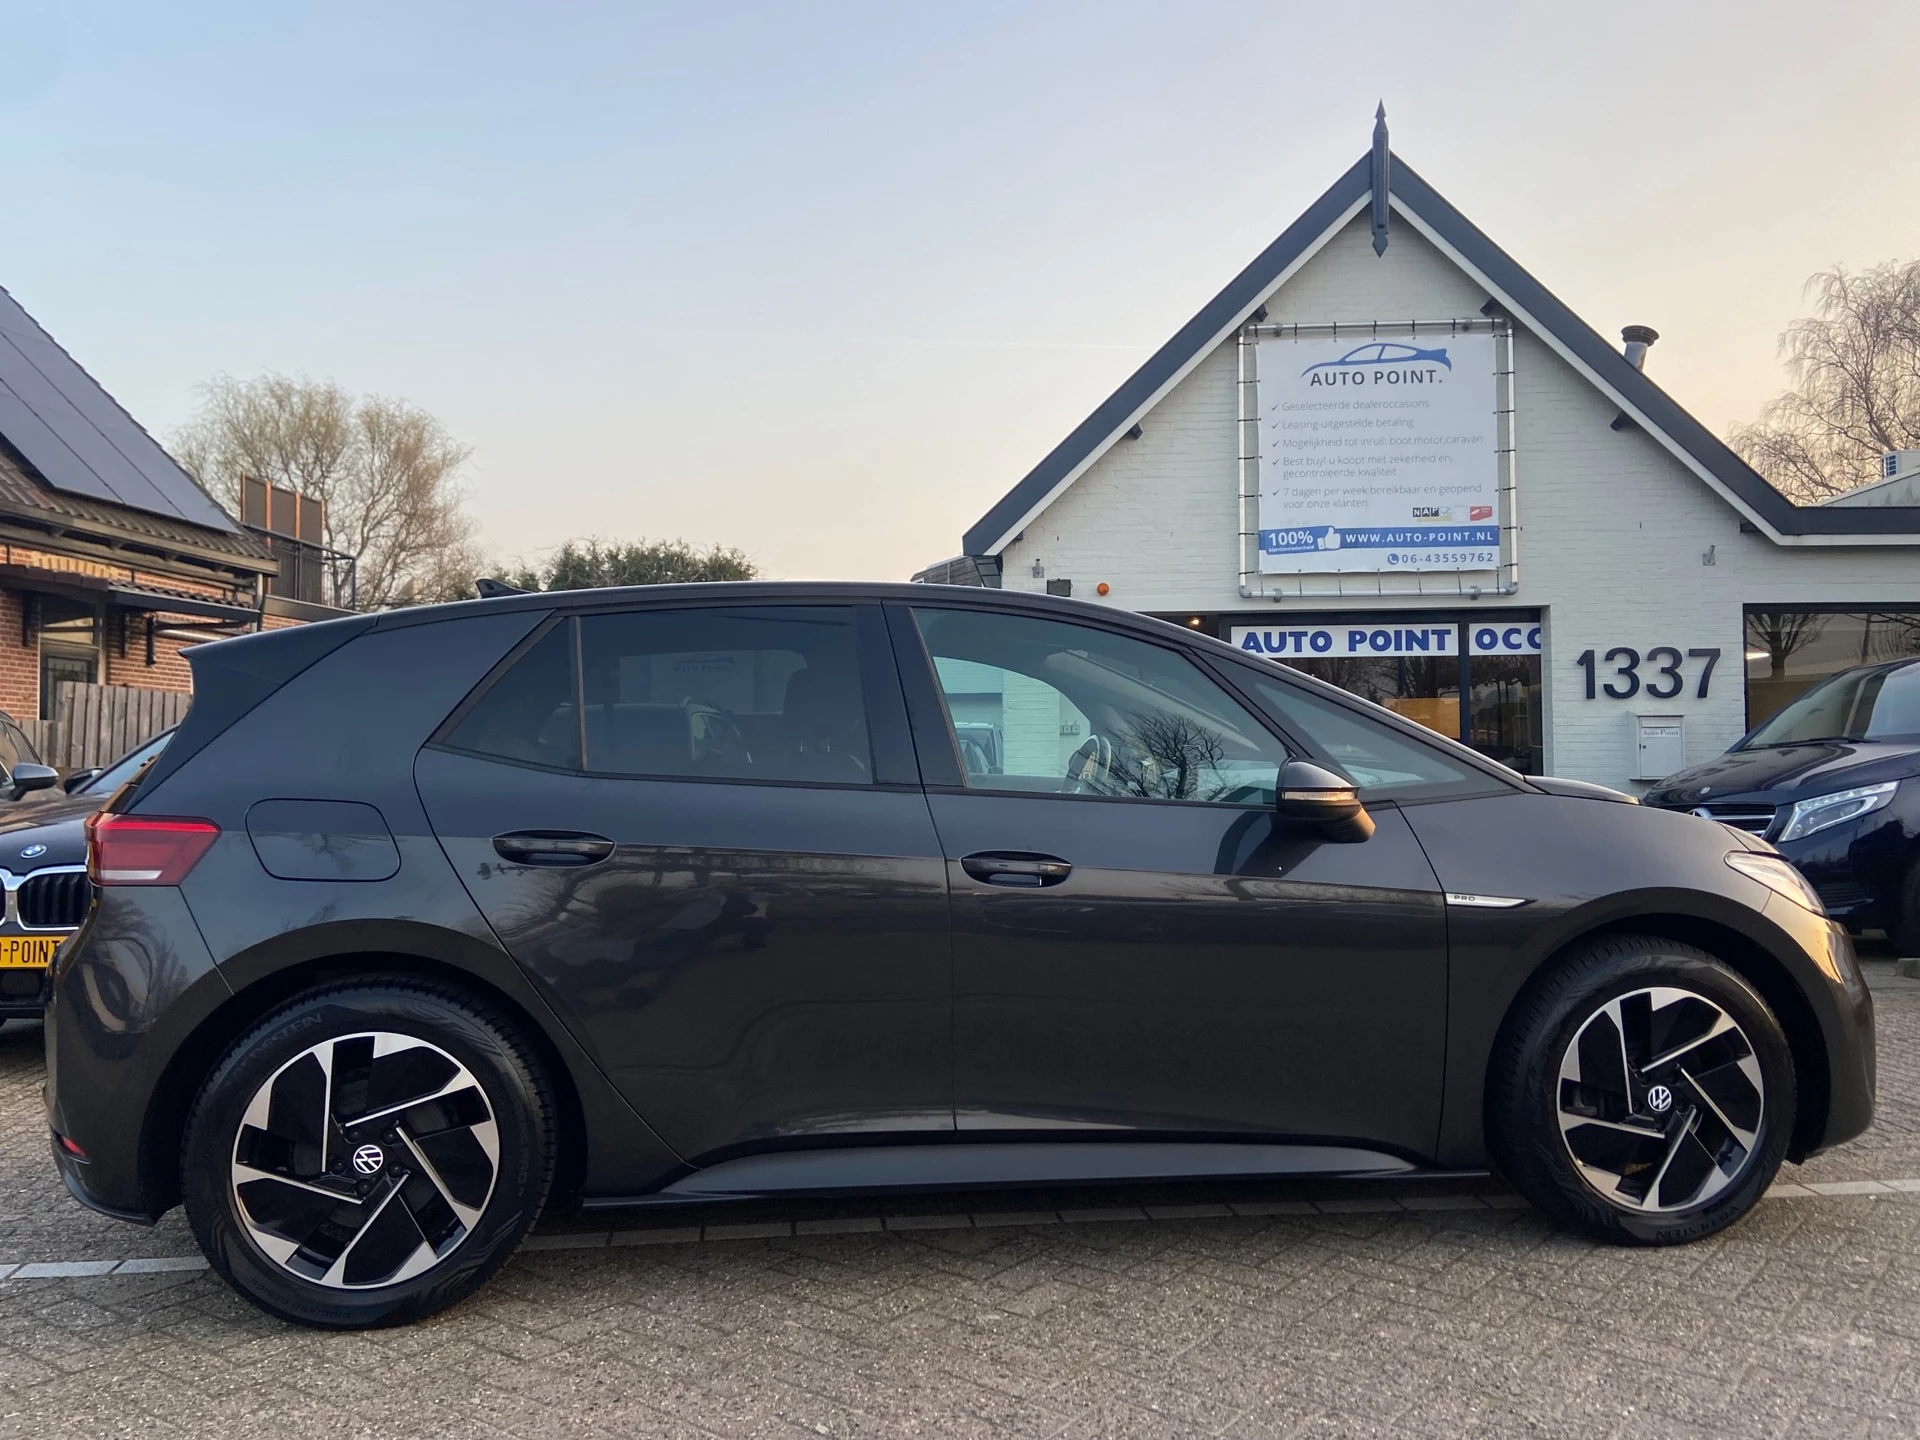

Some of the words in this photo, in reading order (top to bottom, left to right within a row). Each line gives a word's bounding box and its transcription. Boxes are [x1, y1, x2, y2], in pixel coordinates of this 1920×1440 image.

[1310, 371, 1365, 386] AUTO
[1282, 401, 1350, 411] Geselecteerde
[1353, 400, 1430, 410] dealeroccasions
[1282, 418, 1373, 431] Leasing-uitgestelde
[1376, 418, 1414, 429] betaling
[1283, 438, 1341, 450] Mogelijkheid
[1344, 437, 1357, 446] tot
[1283, 457, 1303, 466] Best
[1338, 455, 1364, 467] koopt
[1368, 456, 1386, 464] met
[1389, 454, 1436, 464] zekerheid
[1283, 468, 1355, 480] gecontroleerde
[1358, 467, 1396, 477] kwaliteit
[1284, 487, 1289, 496] 7
[1291, 487, 1320, 498] dagen
[1324, 488, 1340, 497] per
[1343, 485, 1367, 495] week
[1370, 484, 1421, 495] bereikbaar
[1424, 485, 1436, 494] en
[1439, 484, 1482, 496] geopend
[1283, 500, 1305, 509] voor
[1307, 500, 1330, 508] onze
[1333, 498, 1368, 508] klanten
[1412, 507, 1439, 517] NAP
[1269, 530, 1314, 546] 100%
[1346, 531, 1493, 543] WWW.AUTO-POINT.NL
[1401, 553, 1493, 564] 06-43559762
[1241, 630, 1333, 653] AUTO
[1348, 629, 1451, 652] POINT
[1576, 646, 1721, 699] 1337
[1453, 894, 1476, 902] PRO
[0, 940, 61, 964] -POINT
